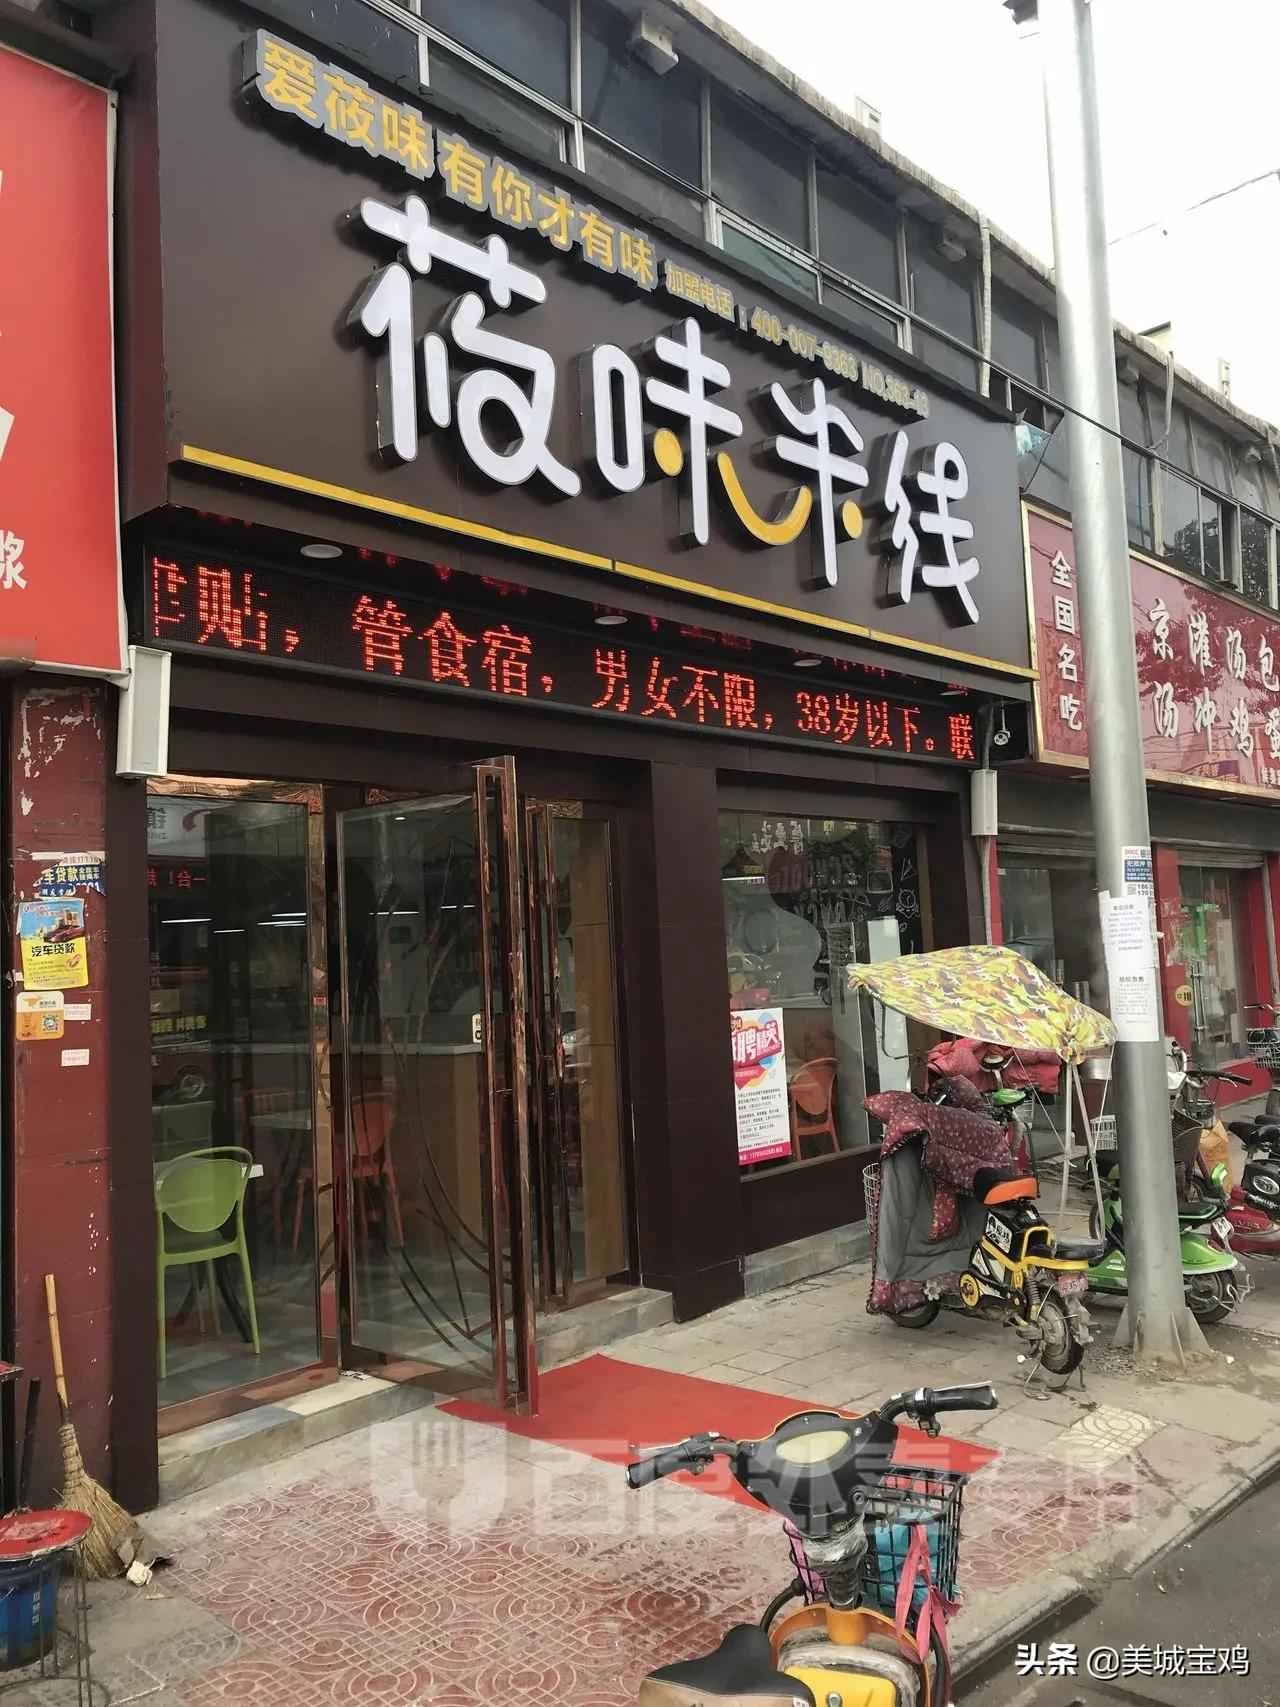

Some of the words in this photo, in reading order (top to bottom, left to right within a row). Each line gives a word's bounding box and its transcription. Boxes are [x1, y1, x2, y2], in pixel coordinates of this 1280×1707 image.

[1051, 550, 1082, 731] 全国名吃
[31, 942, 76, 958] 汽车贷款
